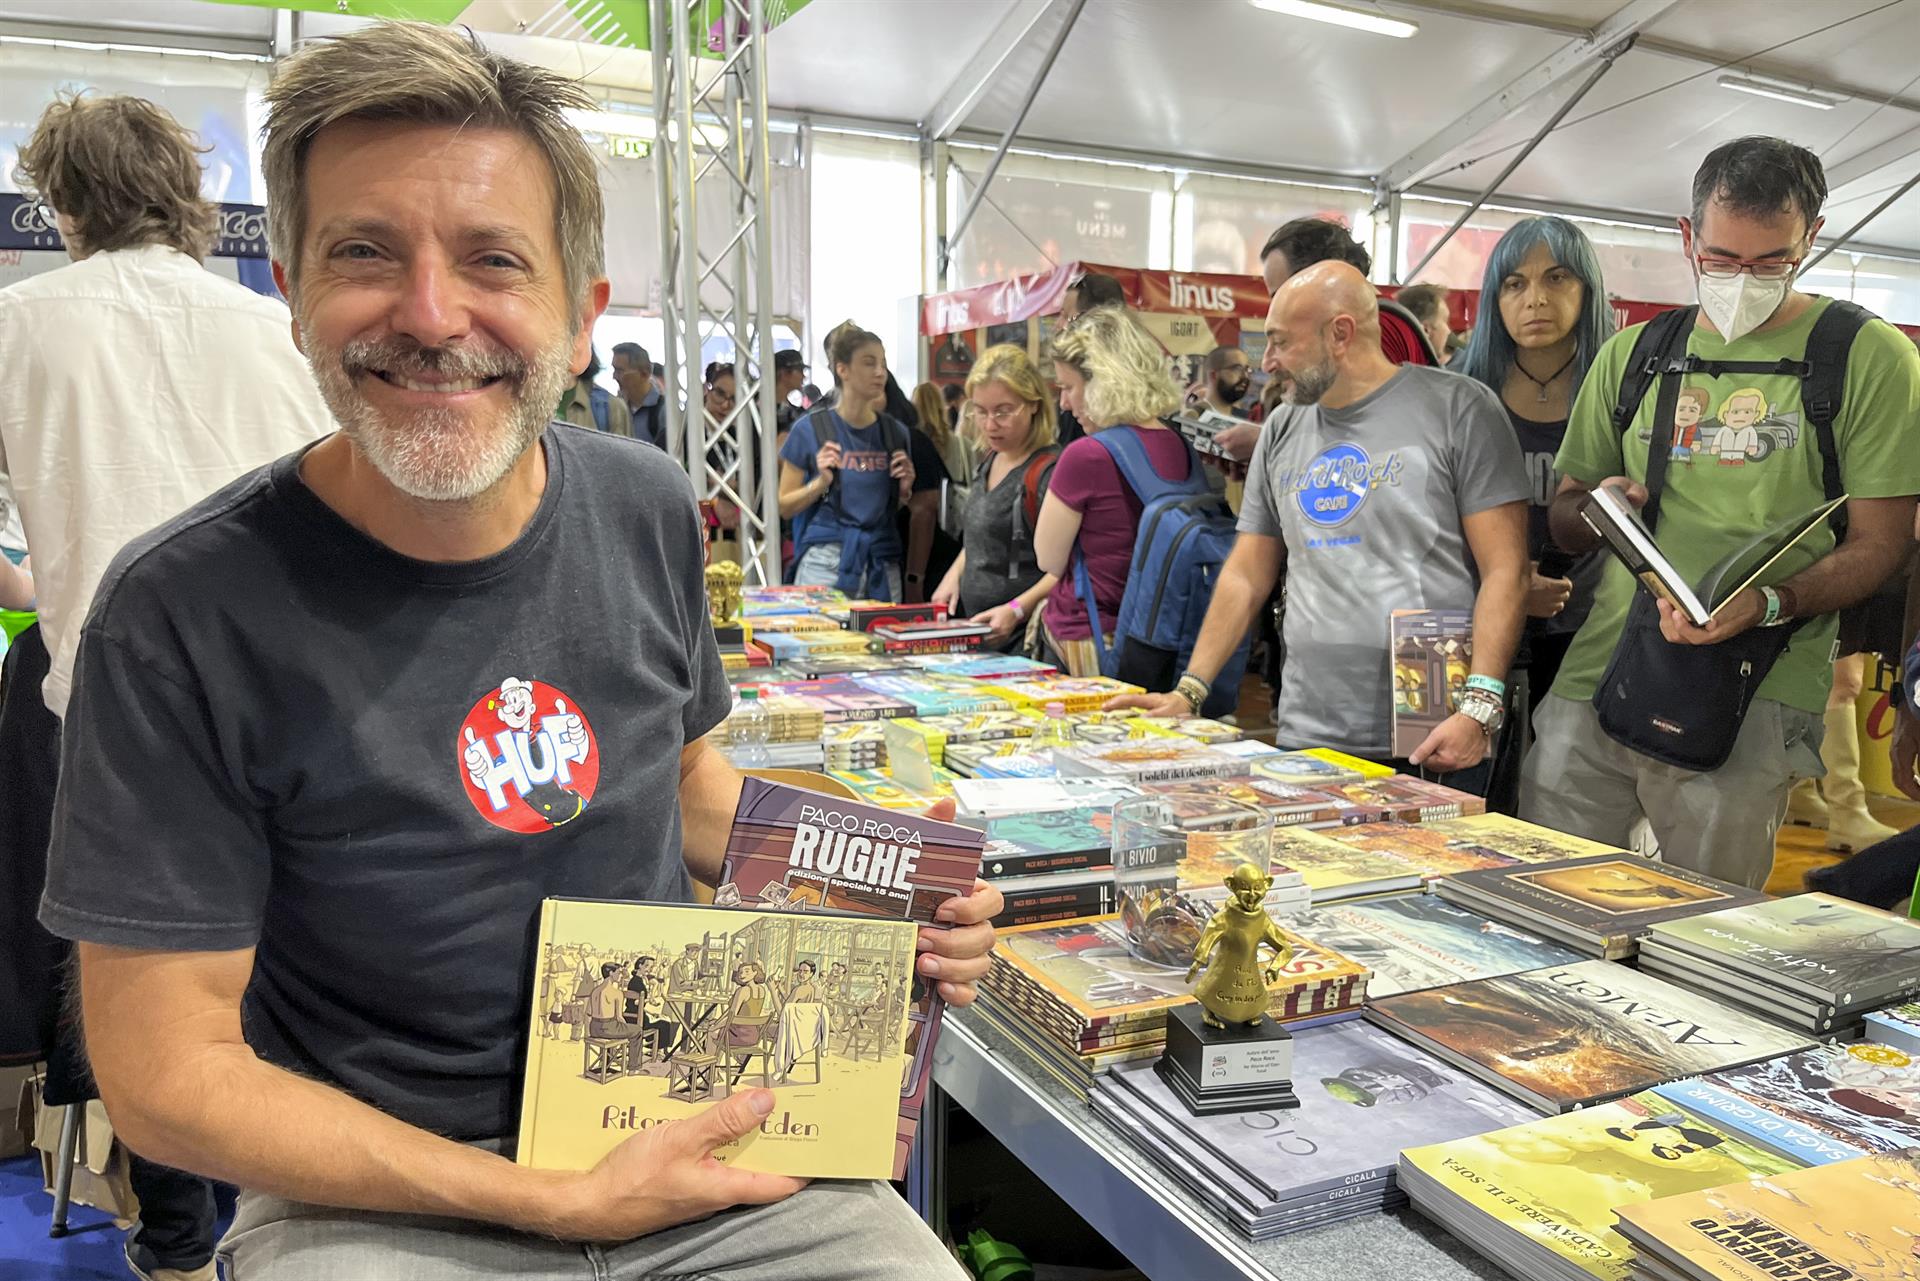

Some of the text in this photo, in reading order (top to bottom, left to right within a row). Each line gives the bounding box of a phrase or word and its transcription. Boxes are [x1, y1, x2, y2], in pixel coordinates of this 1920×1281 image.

[1169, 276, 1235, 312] linus
[1279, 452, 1402, 498] Hard Rock
[468, 713, 581, 811] HUF
[799, 804, 923, 848] PACO ROCA
[788, 822, 922, 892] RUGHE
[1128, 846, 1157, 867] BIVIO
[787, 868, 909, 900] edizione speciale 15 anni
[1703, 926, 1837, 976] nottetempo
[1239, 1112, 1318, 1156] CIC
[1686, 1087, 1848, 1161] SAGA DI GRIMR
[1344, 1170, 1377, 1185] CICALA
[1441, 1156, 1486, 1185] SOFÀ
[1484, 1183, 1504, 1198] IL
[1329, 1186, 1361, 1200] CICALA
[1501, 1195, 1519, 1205] E
[1515, 1202, 1613, 1260] CADAVERE
[1690, 1217, 1809, 1281] AMENTO
[1728, 1216, 1858, 1281] OENIX
